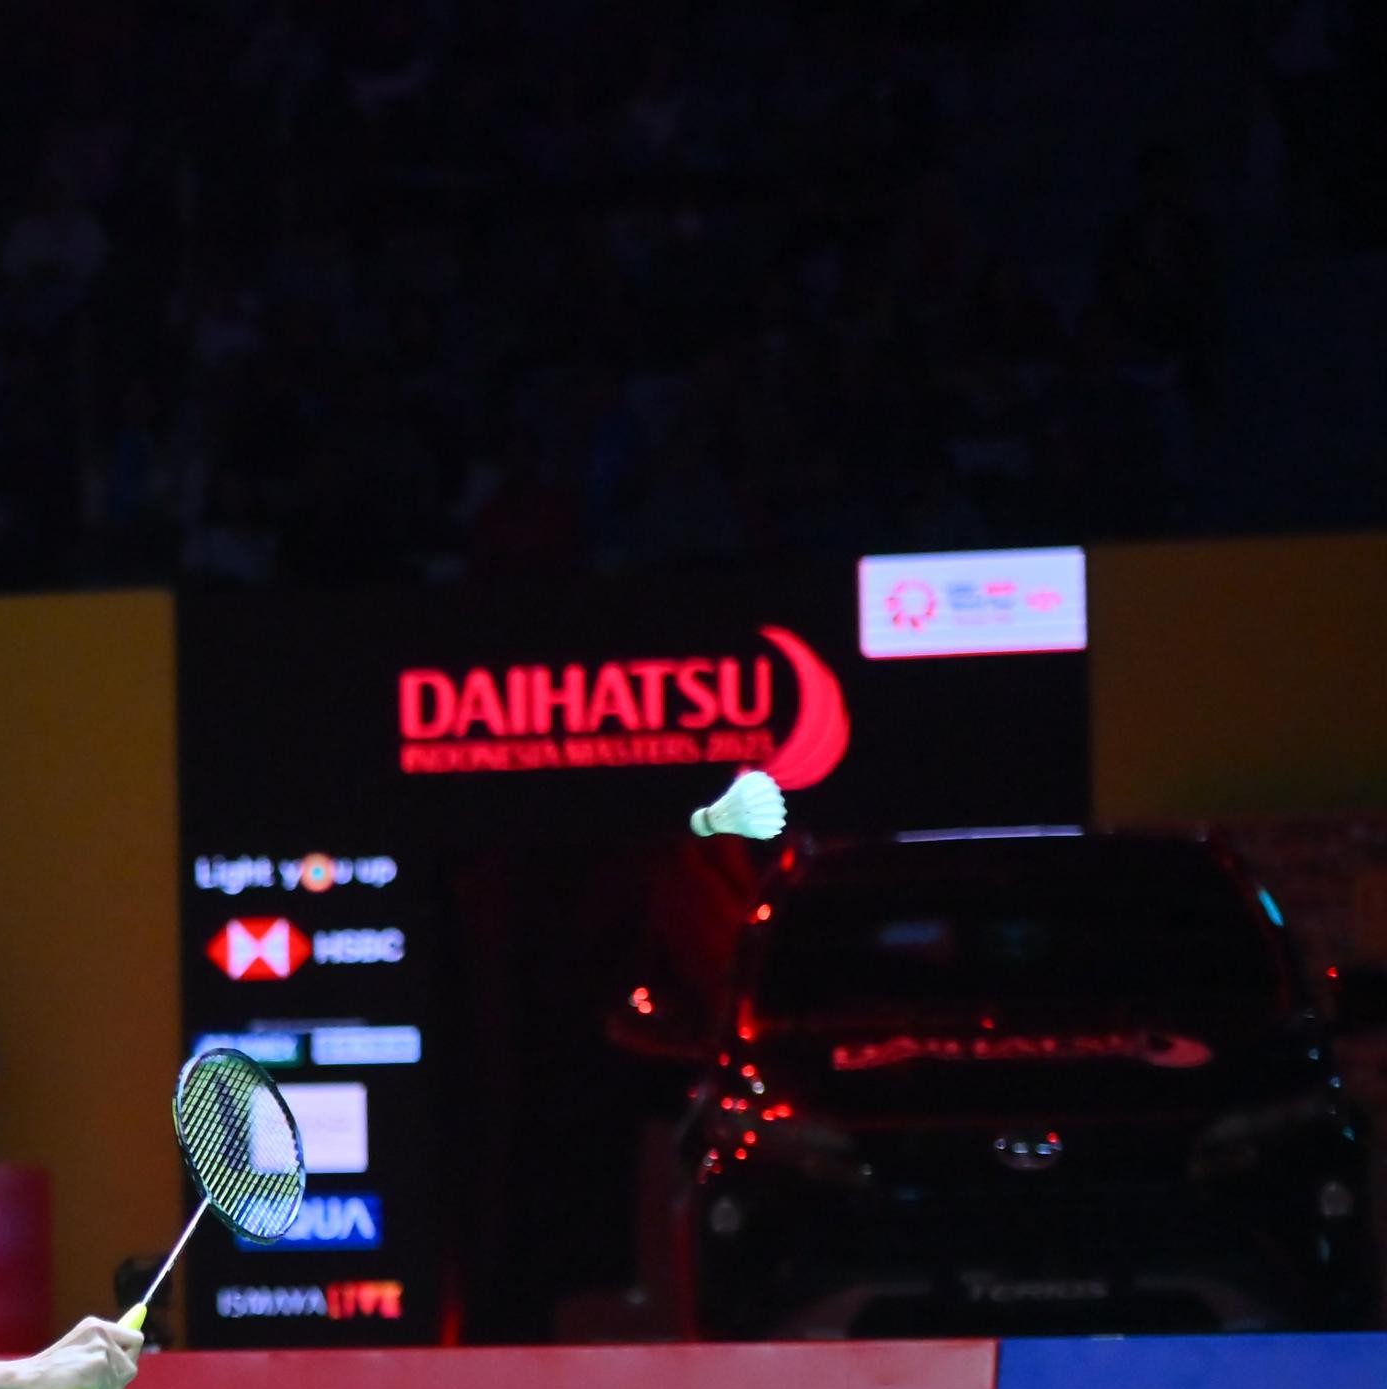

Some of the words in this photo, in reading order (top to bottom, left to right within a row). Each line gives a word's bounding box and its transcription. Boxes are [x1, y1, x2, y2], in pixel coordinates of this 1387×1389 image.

[398, 656, 774, 739] DAIHATSU
[400, 741, 559, 773] INDONESIA
[563, 734, 701, 768] MASTERS
[194, 855, 274, 895] Light
[355, 855, 398, 888] up
[313, 927, 406, 965] HSBC
